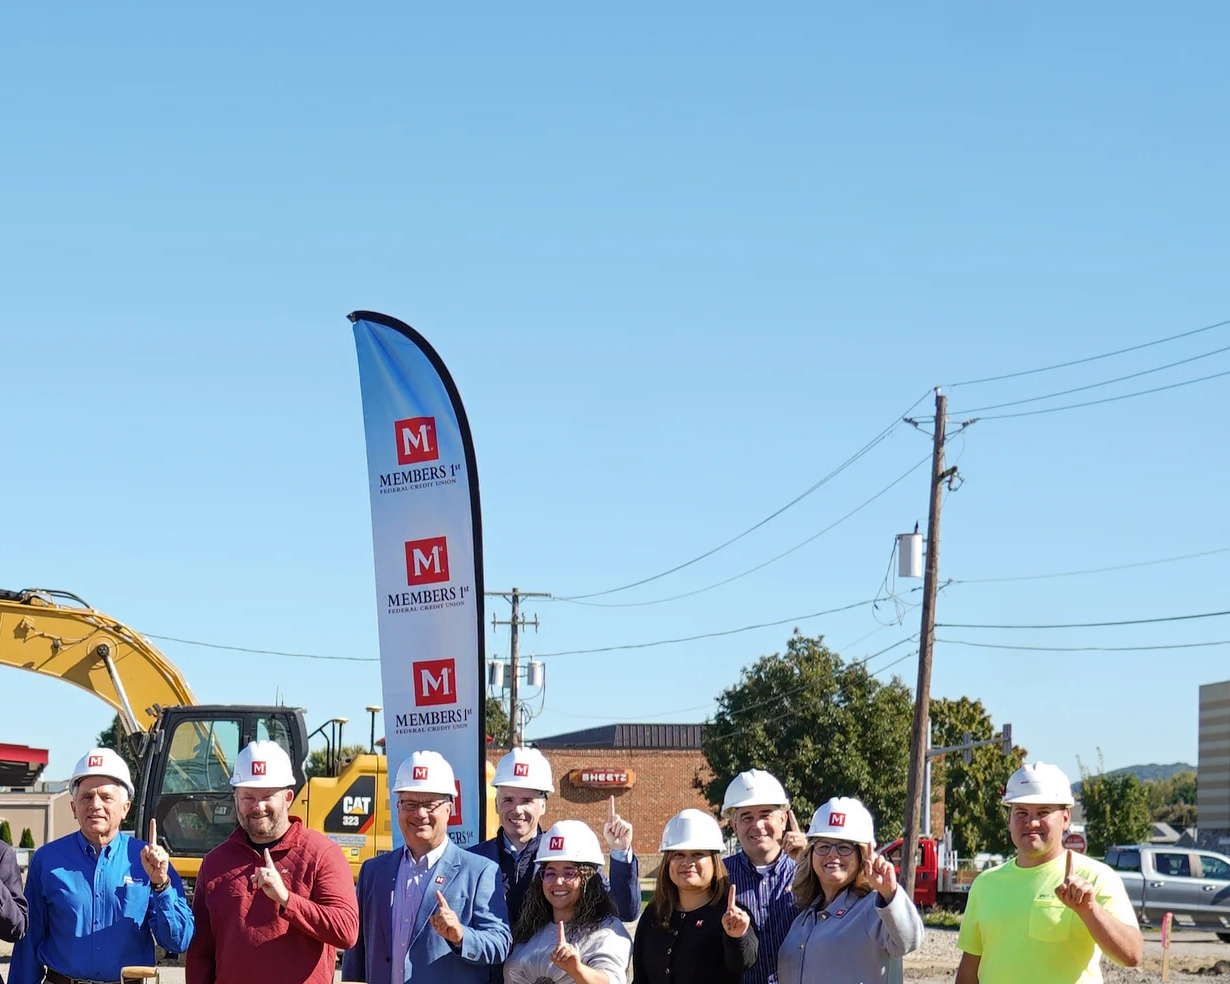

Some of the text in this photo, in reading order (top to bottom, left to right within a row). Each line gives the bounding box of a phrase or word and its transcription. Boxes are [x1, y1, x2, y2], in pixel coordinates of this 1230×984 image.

[380, 464, 461, 488] MEMBERS 1st
[380, 478, 457, 494] FEDERAL CREDIT UNION
[388, 585, 469, 607] MEMBERS 1st
[388, 606, 418, 614] FEDERAL
[445, 600, 465, 608] UNION
[395, 708, 473, 728] MEMBERS 1st
[395, 727, 426, 735] FEDERAL
[427, 725, 451, 733] CREDIT
[90, 756, 101, 766] M
[254, 763, 265, 773] M
[415, 768, 426, 778] M
[516, 764, 527, 775] M
[582, 773, 627, 782] SHEETZ
[343, 796, 371, 814] CAT
[342, 815, 359, 826] 323
[831, 814, 843, 825] M
[551, 838, 562, 848] M
